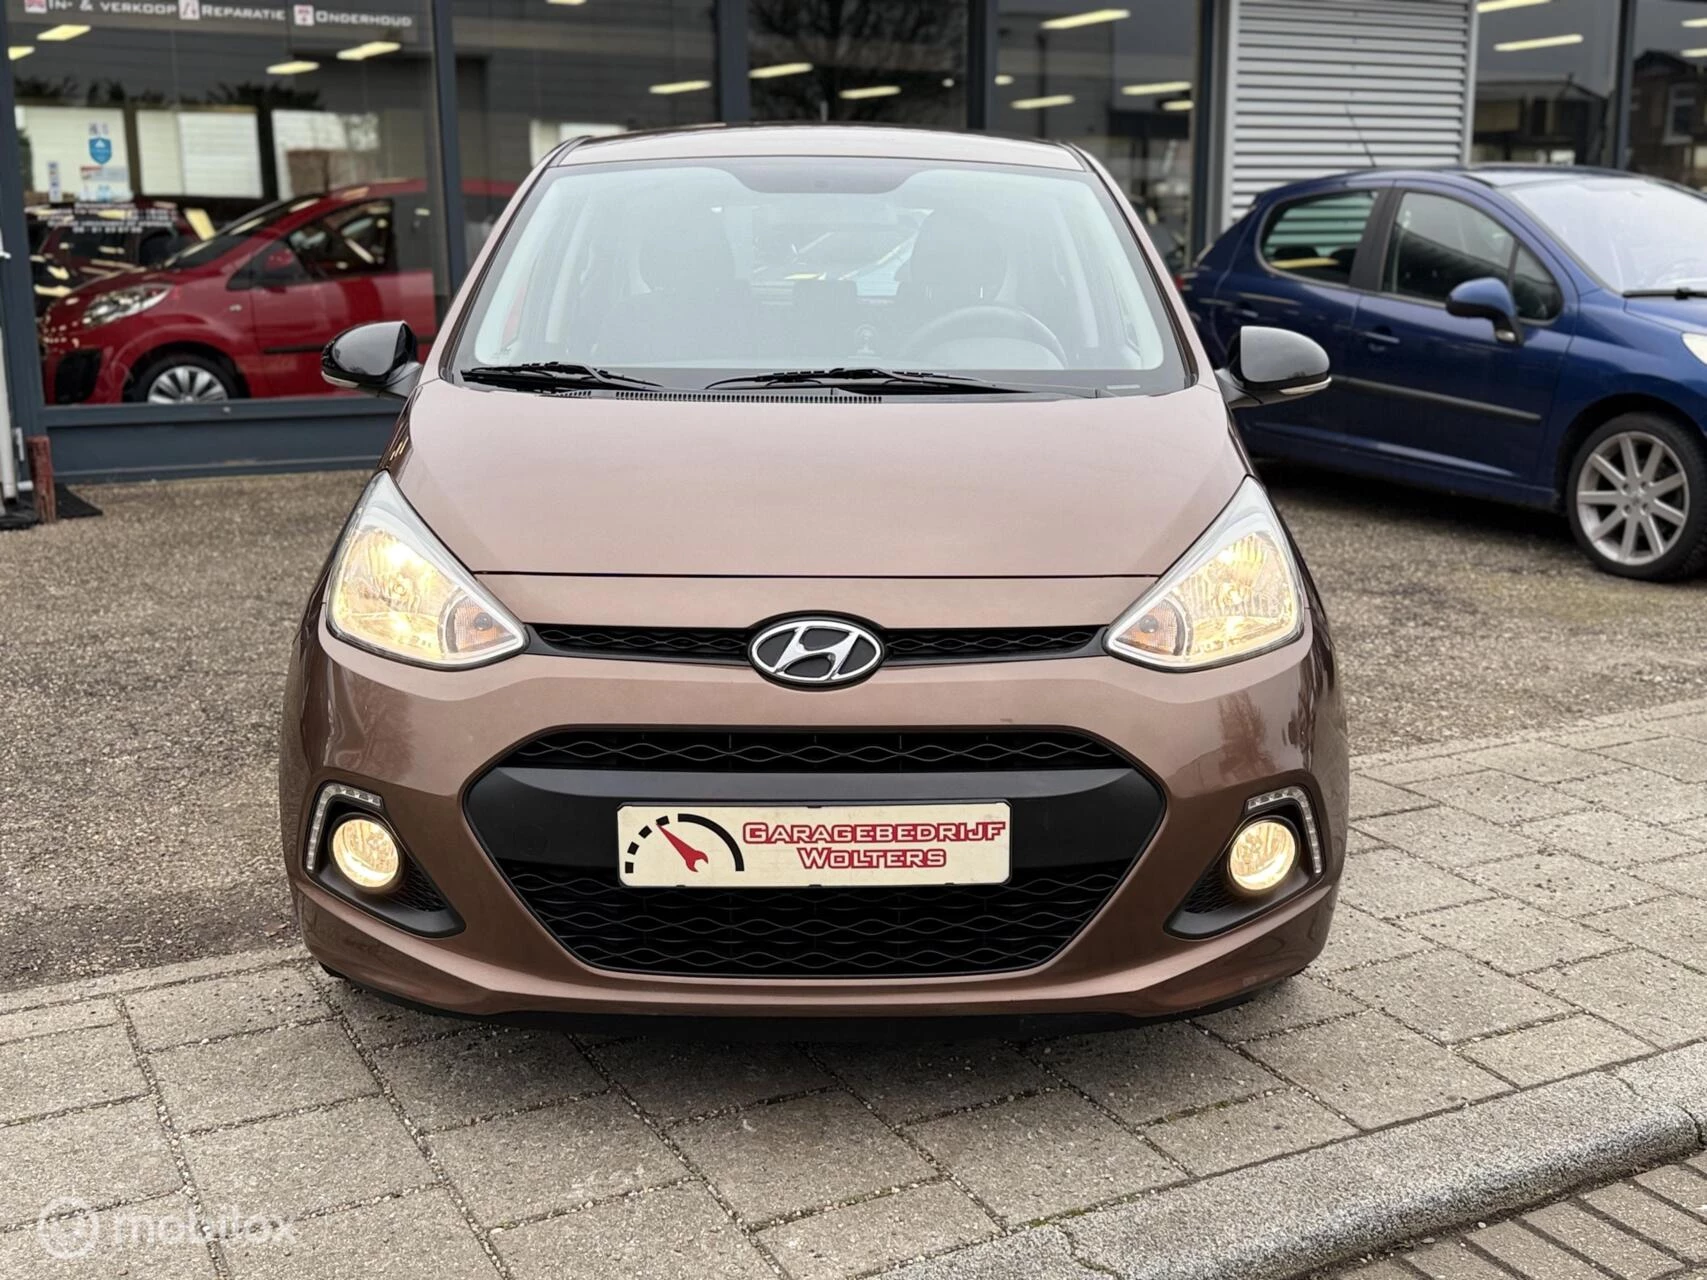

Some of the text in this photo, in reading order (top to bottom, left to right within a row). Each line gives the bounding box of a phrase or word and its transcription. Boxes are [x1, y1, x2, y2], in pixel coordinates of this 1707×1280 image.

[80, 1, 94, 11] &
[100, 3, 177, 14] VERKOOP
[201, 4, 286, 21] REPARATIE
[315, 11, 412, 27] ONDERHOUD
[743, 821, 1006, 843] GARAGEBEDRIJF
[796, 847, 946, 869] WOLTERS
